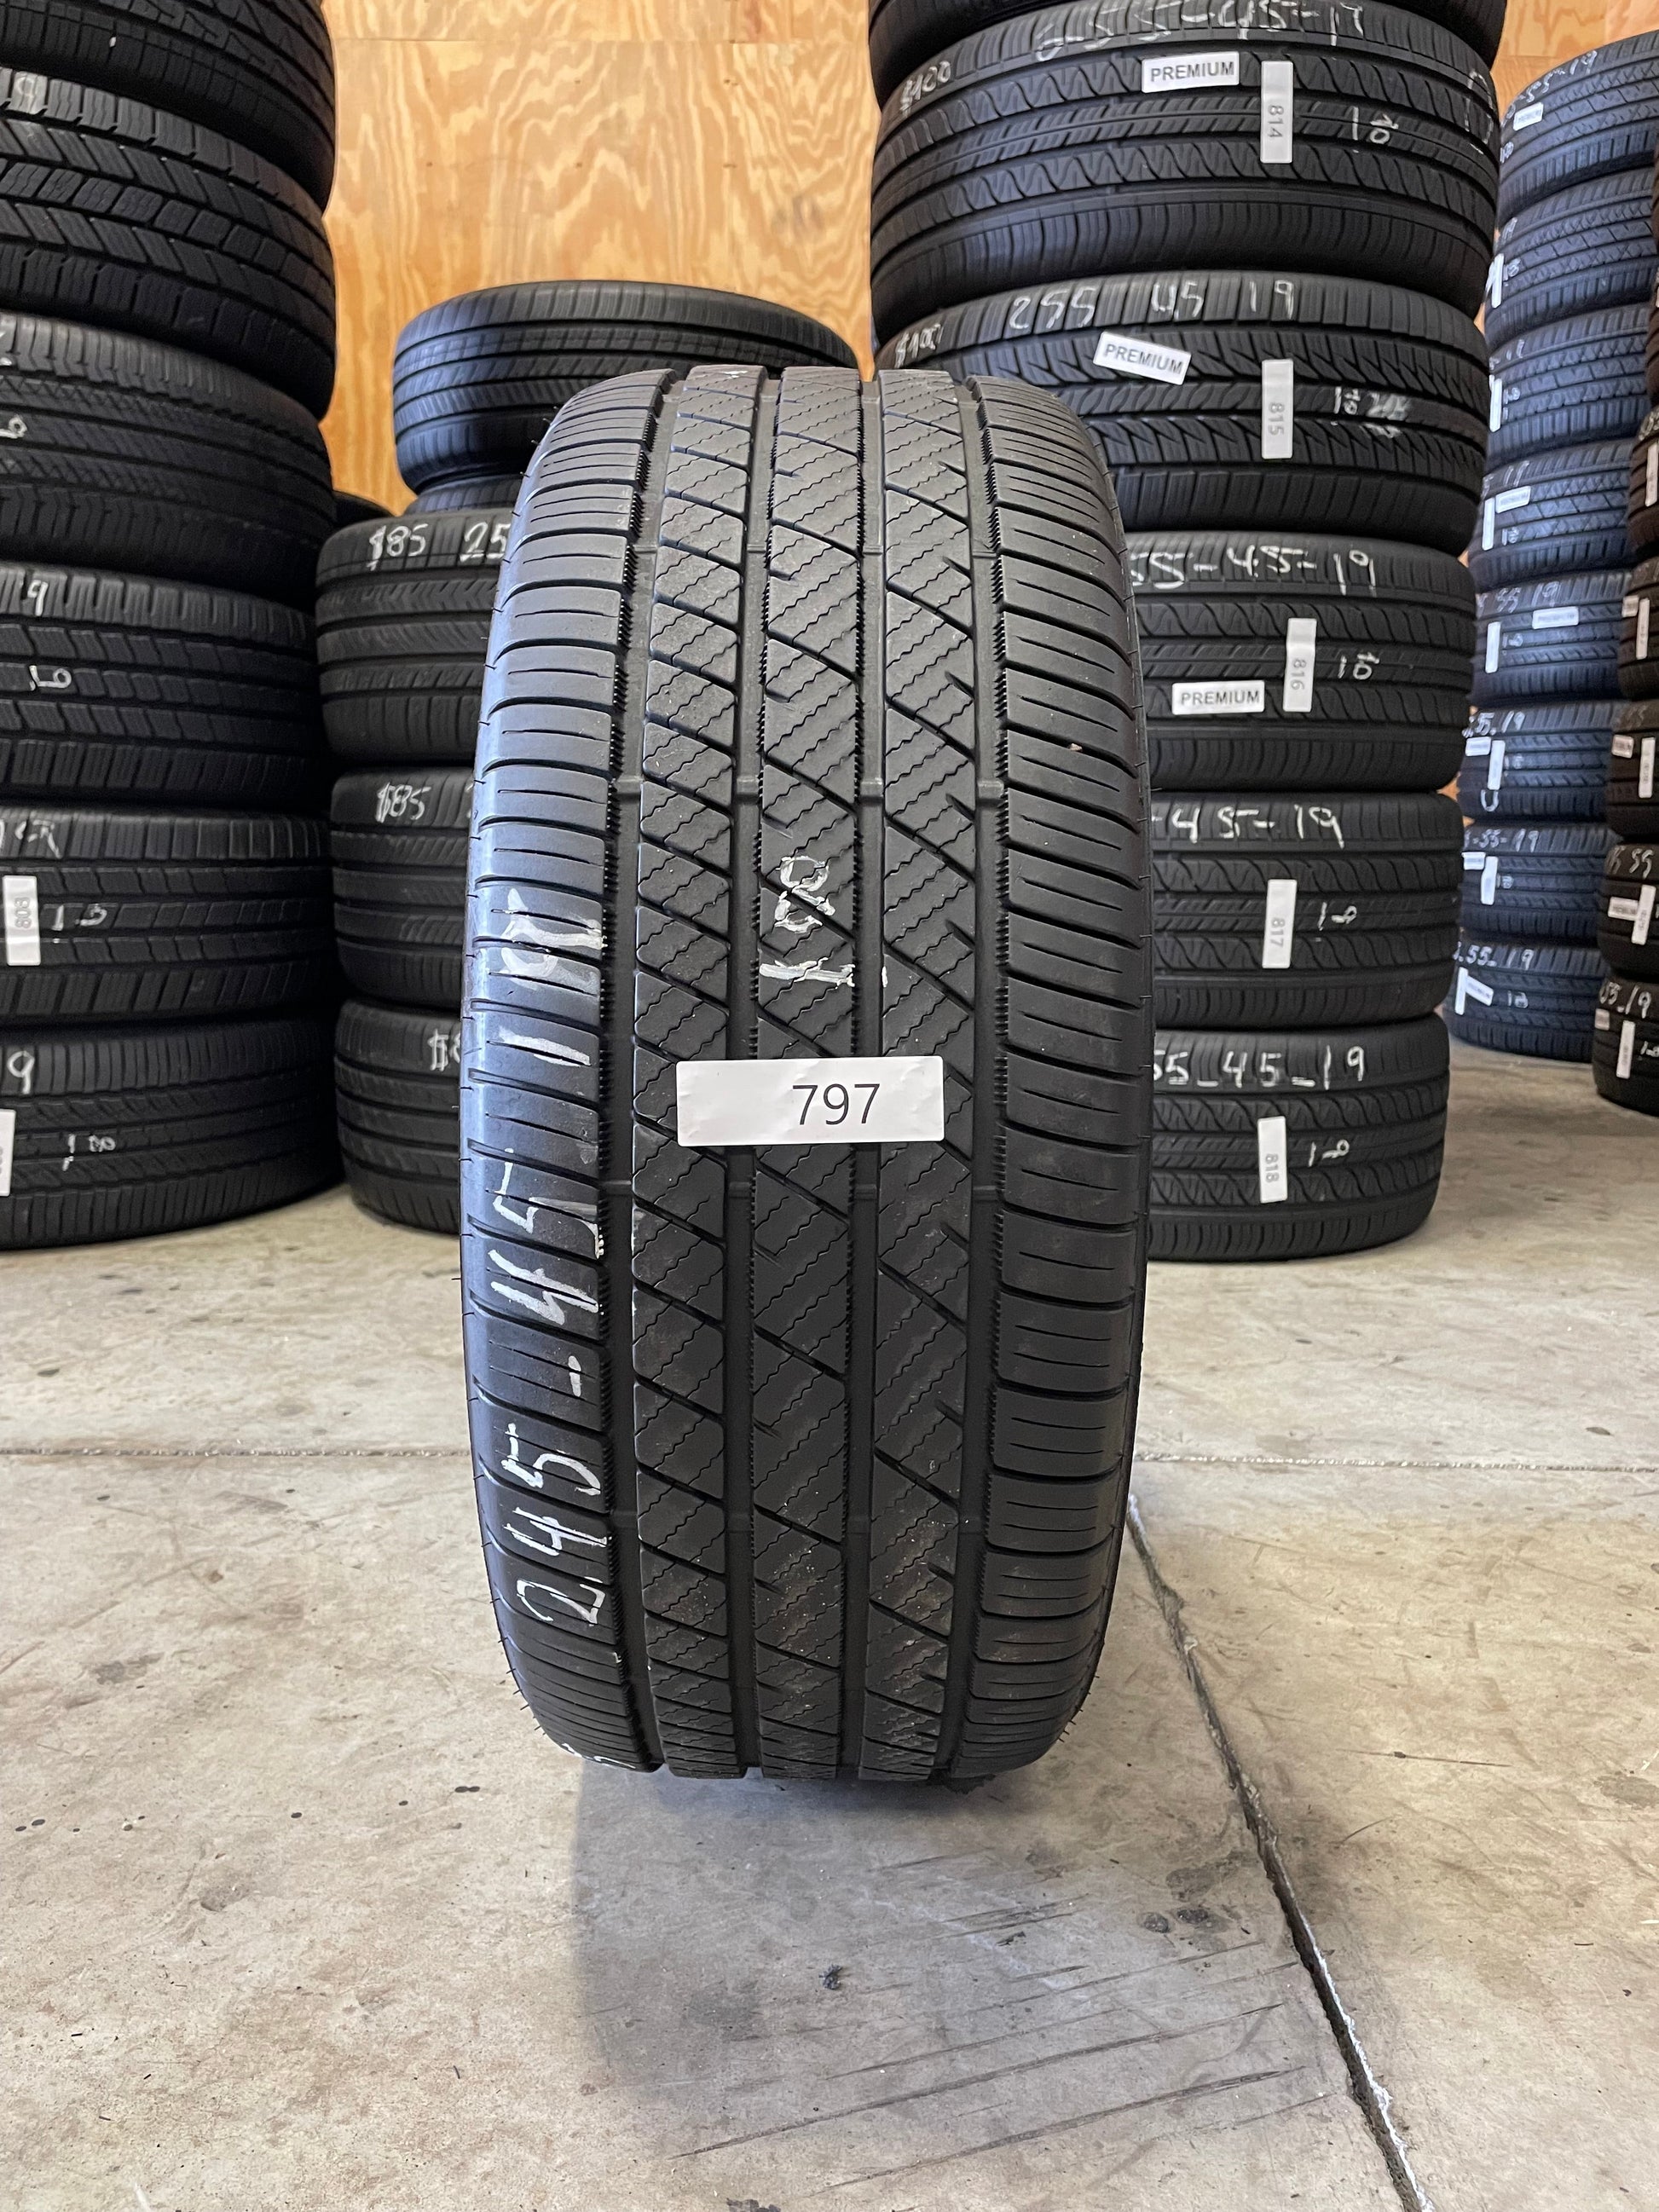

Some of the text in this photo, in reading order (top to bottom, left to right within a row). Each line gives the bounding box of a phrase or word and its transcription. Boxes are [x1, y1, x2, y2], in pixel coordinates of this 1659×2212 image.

[1150, 60, 1235, 83] PREMIUM
[1267, 104, 1285, 139] 814
[1009, 287, 1097, 330] 255
[1249, 280, 1295, 320] 19
[1104, 344, 1184, 375] PREMIUM
[1268, 401, 1286, 436] 815
[1292, 658, 1307, 691] 816
[1181, 691, 1261, 707] PREMIUM
[1269, 916, 1287, 948] 817
[7, 1050, 35, 1094] 9
[792, 1083, 881, 1126] 797
[1264, 1153, 1280, 1183] 818
